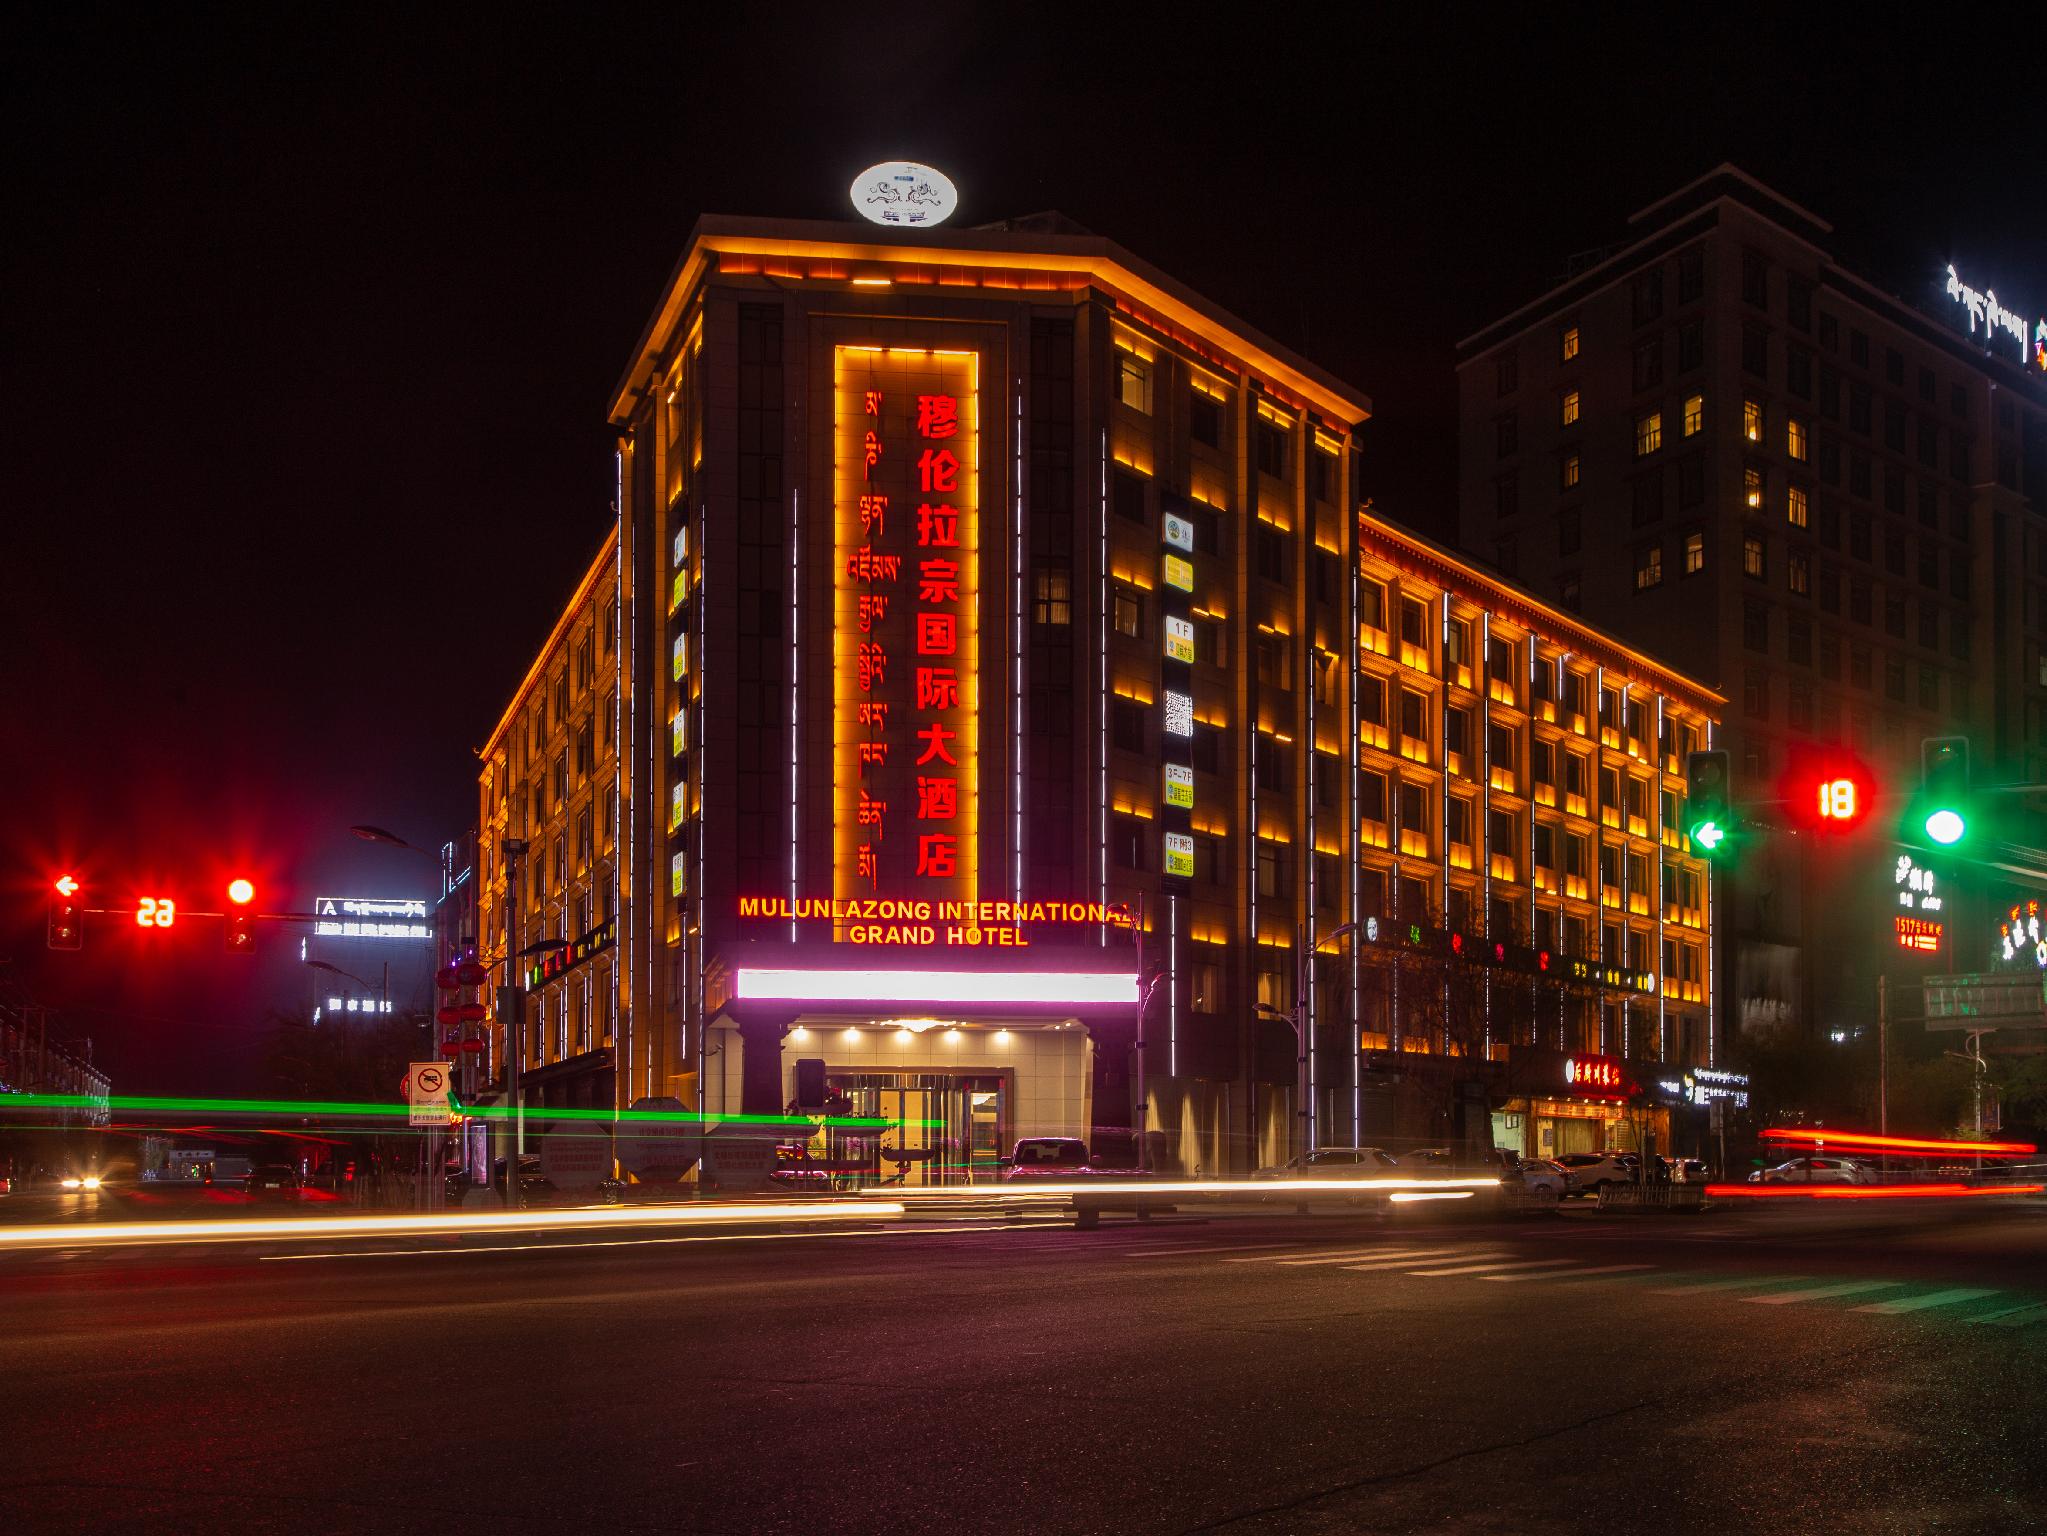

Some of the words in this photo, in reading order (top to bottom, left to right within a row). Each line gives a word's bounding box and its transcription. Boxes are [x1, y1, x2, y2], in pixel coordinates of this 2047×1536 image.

[916, 395, 961, 877] 穆伦拉宗国际大酒店
[739, 897, 932, 921] MULUNLAZONG
[849, 924, 935, 945] GRAND
[947, 926, 1028, 946] HOTEL
